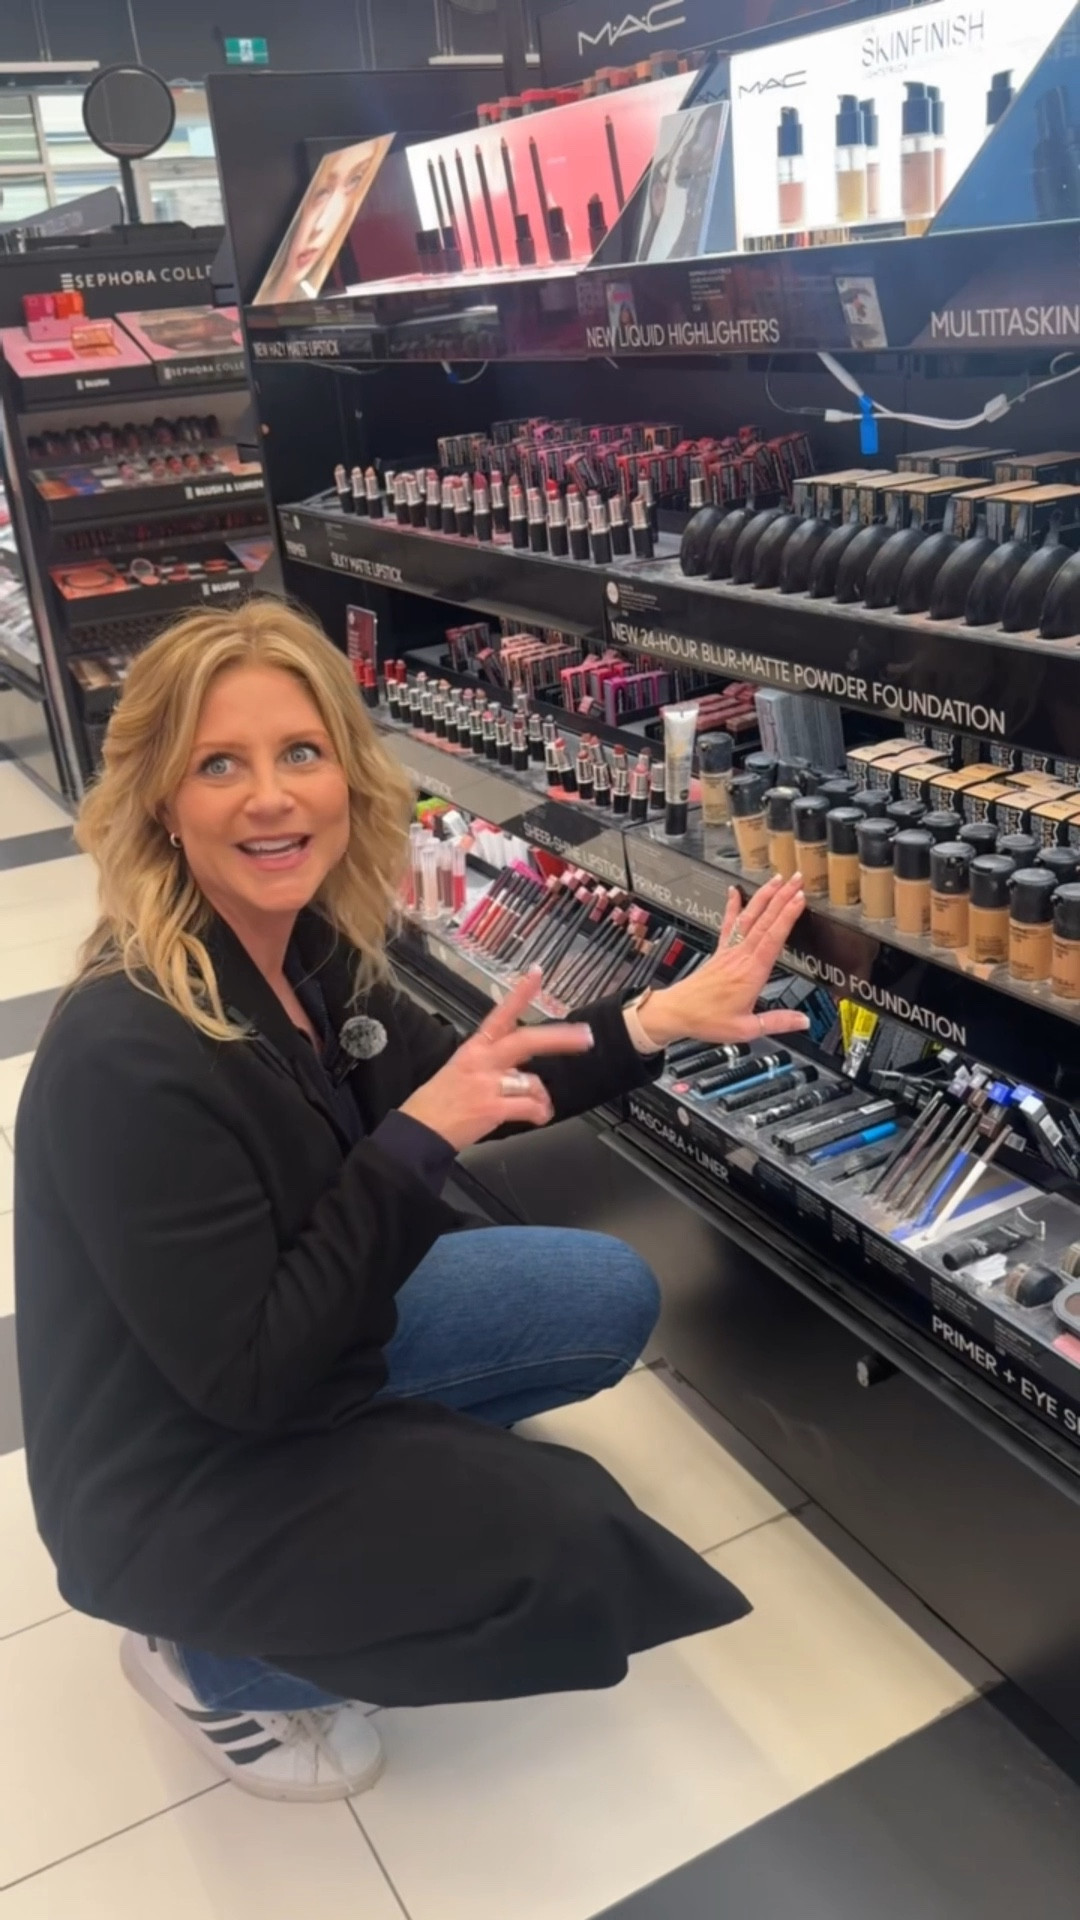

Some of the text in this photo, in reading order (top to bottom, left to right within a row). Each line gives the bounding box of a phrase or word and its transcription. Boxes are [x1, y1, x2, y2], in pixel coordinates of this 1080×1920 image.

[861, 11, 985, 68] SKINFINISH
[738, 70, 807, 99] MAC
[75, 268, 157, 289] SEPHORA
[586, 318, 781, 349] NEW LIQUID HIGHLIGHTERS
[931, 304, 1080, 338] MULTITASKIN
[611, 621, 1005, 735] NEW 24-HOUR BLUR-MATTE POWDER FOUNDATION
[632, 872, 673, 906] PRIMER
[794, 947, 846, 988] LIQUID
[849, 974, 967, 1046] FOUNDATION
[629, 1101, 687, 1153] MASCARA
[695, 1147, 729, 1183] LINER
[931, 1314, 999, 1377] PRIMER
[1003, 1368, 1016, 1384] +
[1020, 1376, 1059, 1419] EYE
